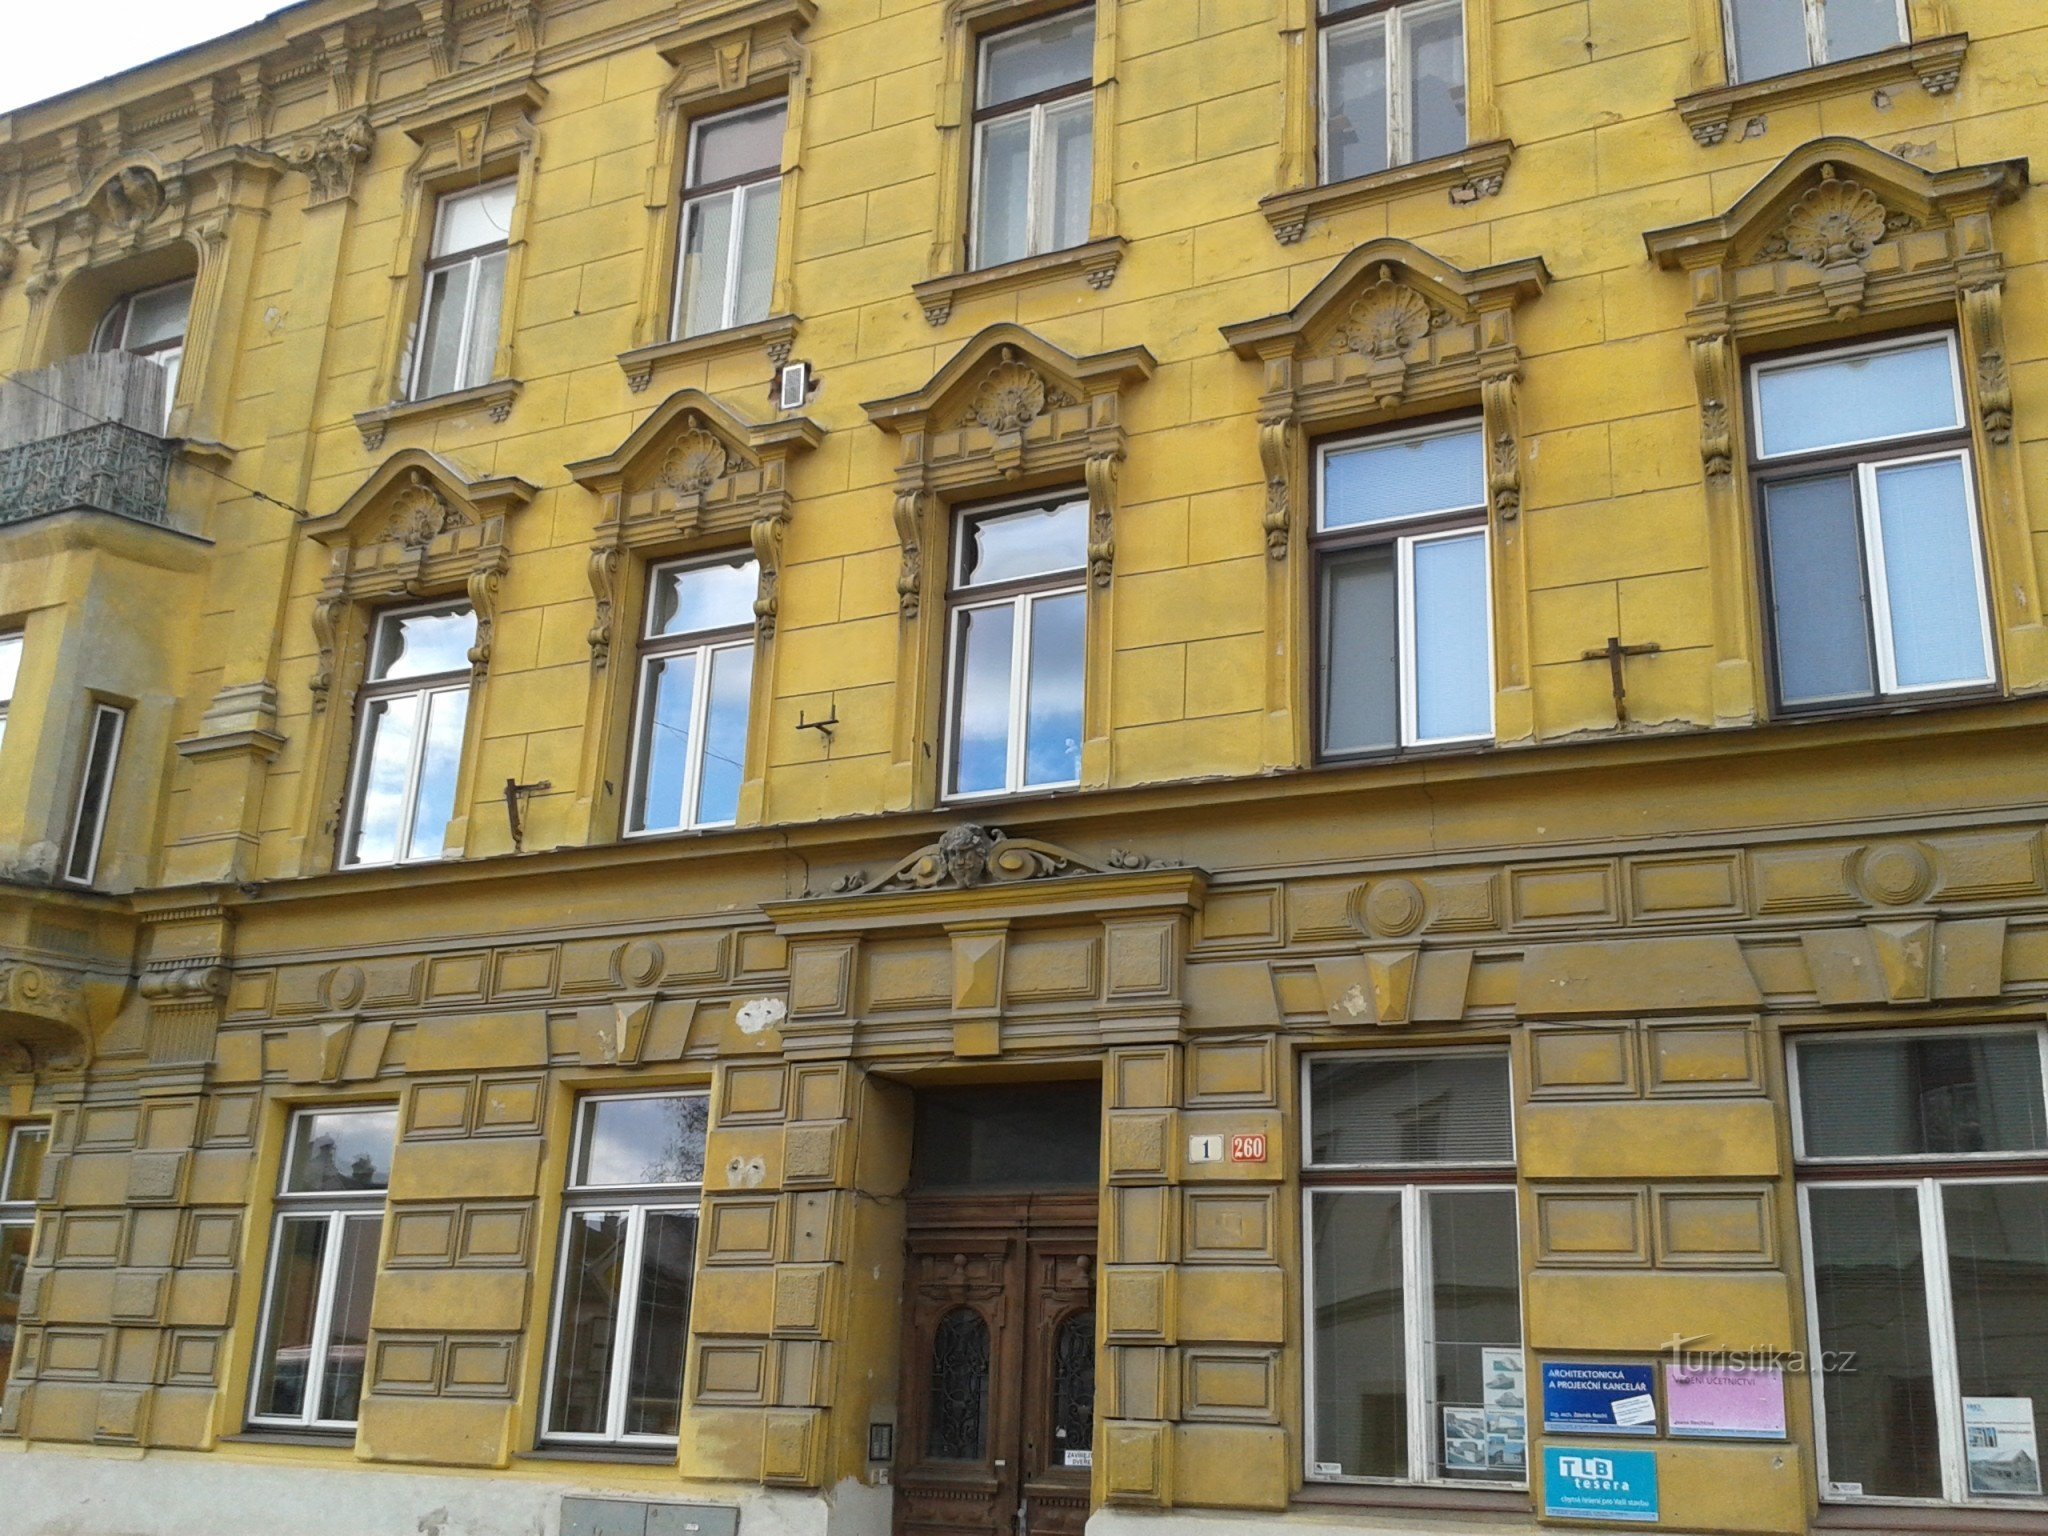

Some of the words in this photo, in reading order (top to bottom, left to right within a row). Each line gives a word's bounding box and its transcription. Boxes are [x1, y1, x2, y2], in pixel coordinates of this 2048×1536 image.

[1203, 1139, 1209, 1158] 1
[1234, 1137, 1262, 1157] 260
[1548, 1369, 1625, 1379] ARCHITEKTONICKÁ
[1549, 1381, 1556, 1389] A
[1557, 1380, 1601, 1390] PROJEKČNÍ
[1602, 1382, 1647, 1391] KANCELÁŘ
[1561, 1458, 1610, 1477] TLB
[1574, 1478, 1629, 1491] tesera
